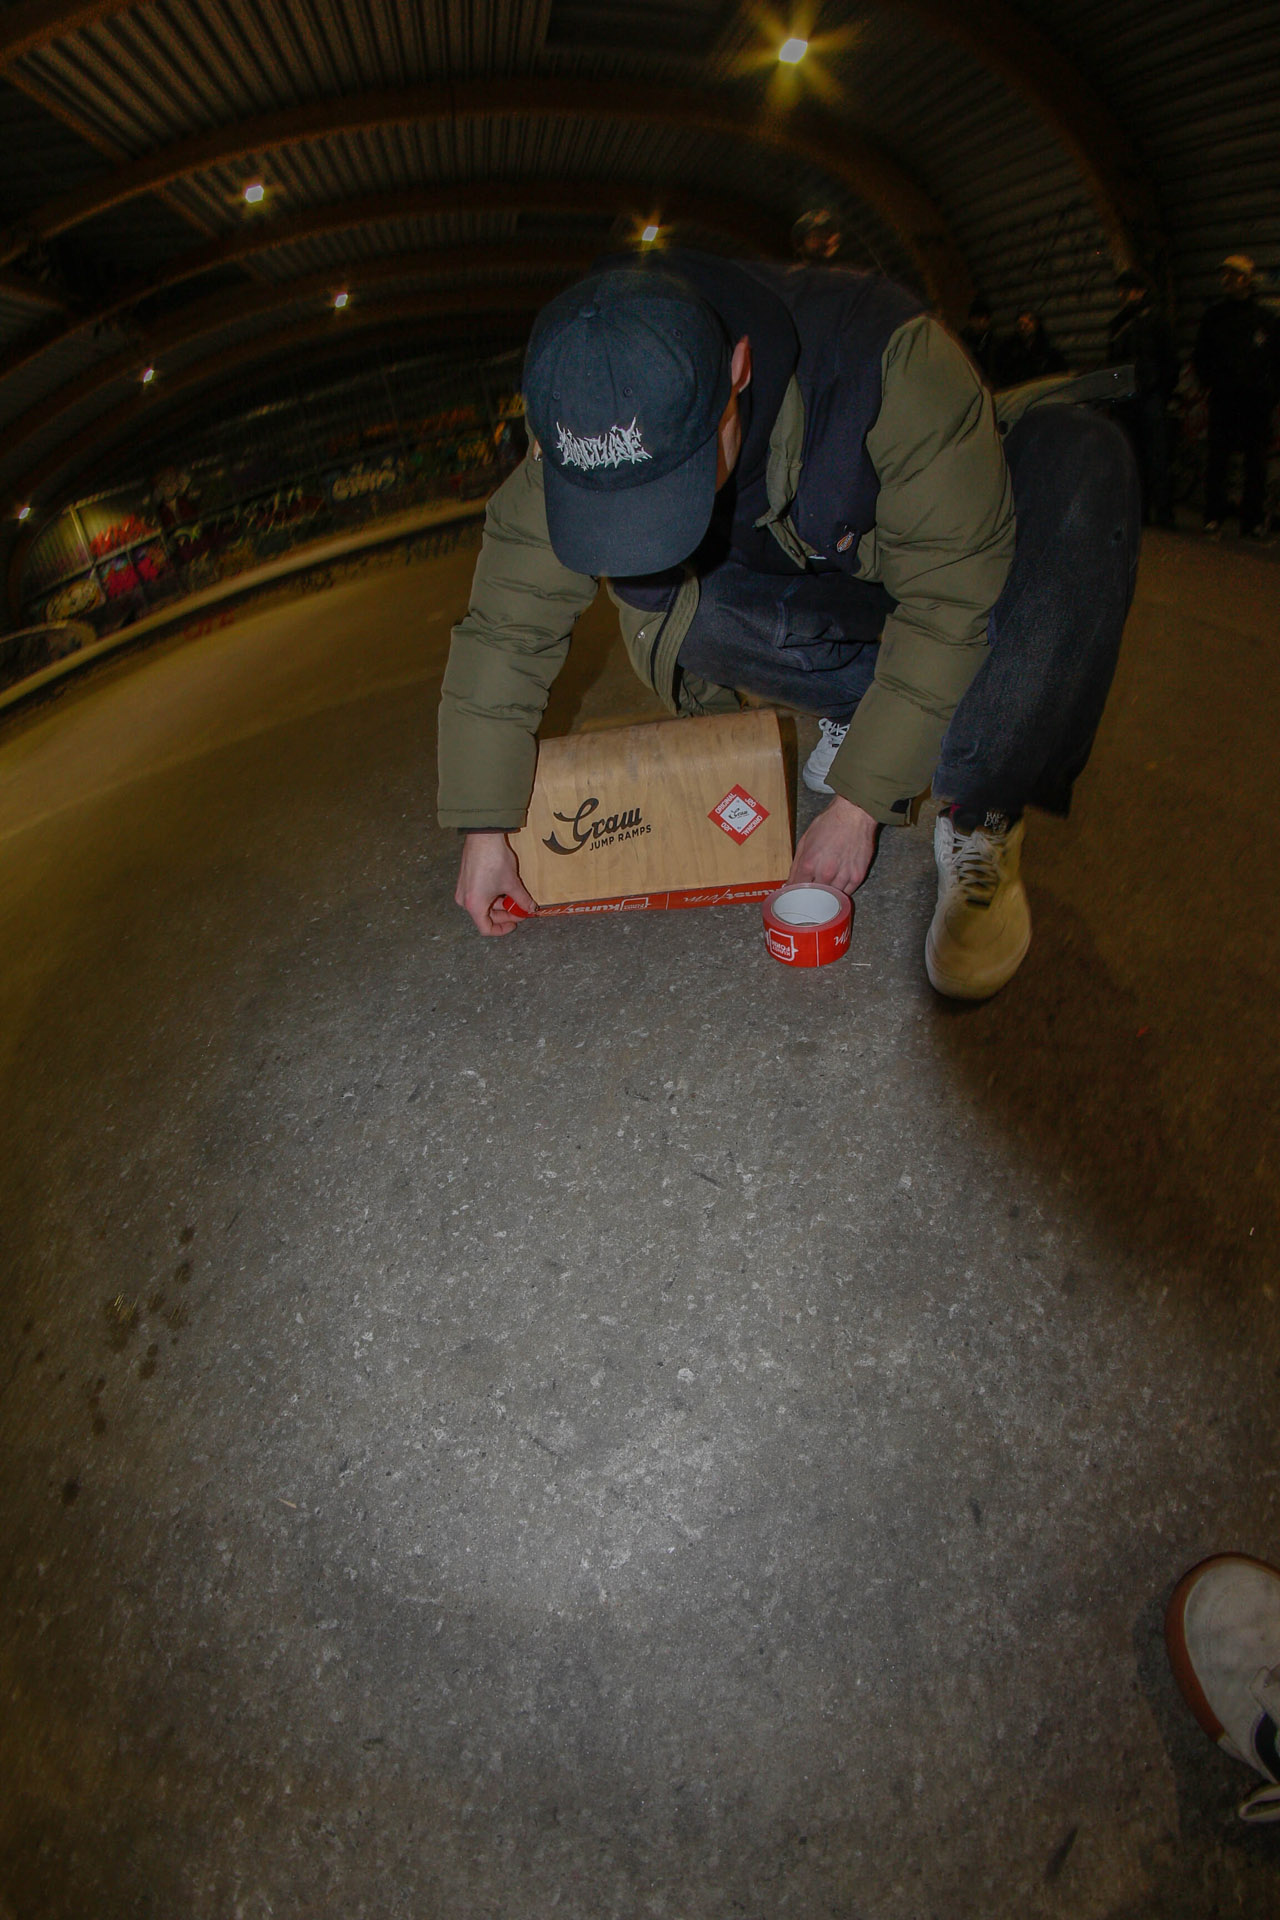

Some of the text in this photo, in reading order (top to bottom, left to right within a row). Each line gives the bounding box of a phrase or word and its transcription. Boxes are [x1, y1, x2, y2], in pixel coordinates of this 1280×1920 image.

[714, 792, 737, 814] ORIGINAL
[541, 798, 642, 855] Graw
[589, 824, 652, 851] JUMP RAMPS
[740, 815, 763, 836] ORIGINAL
